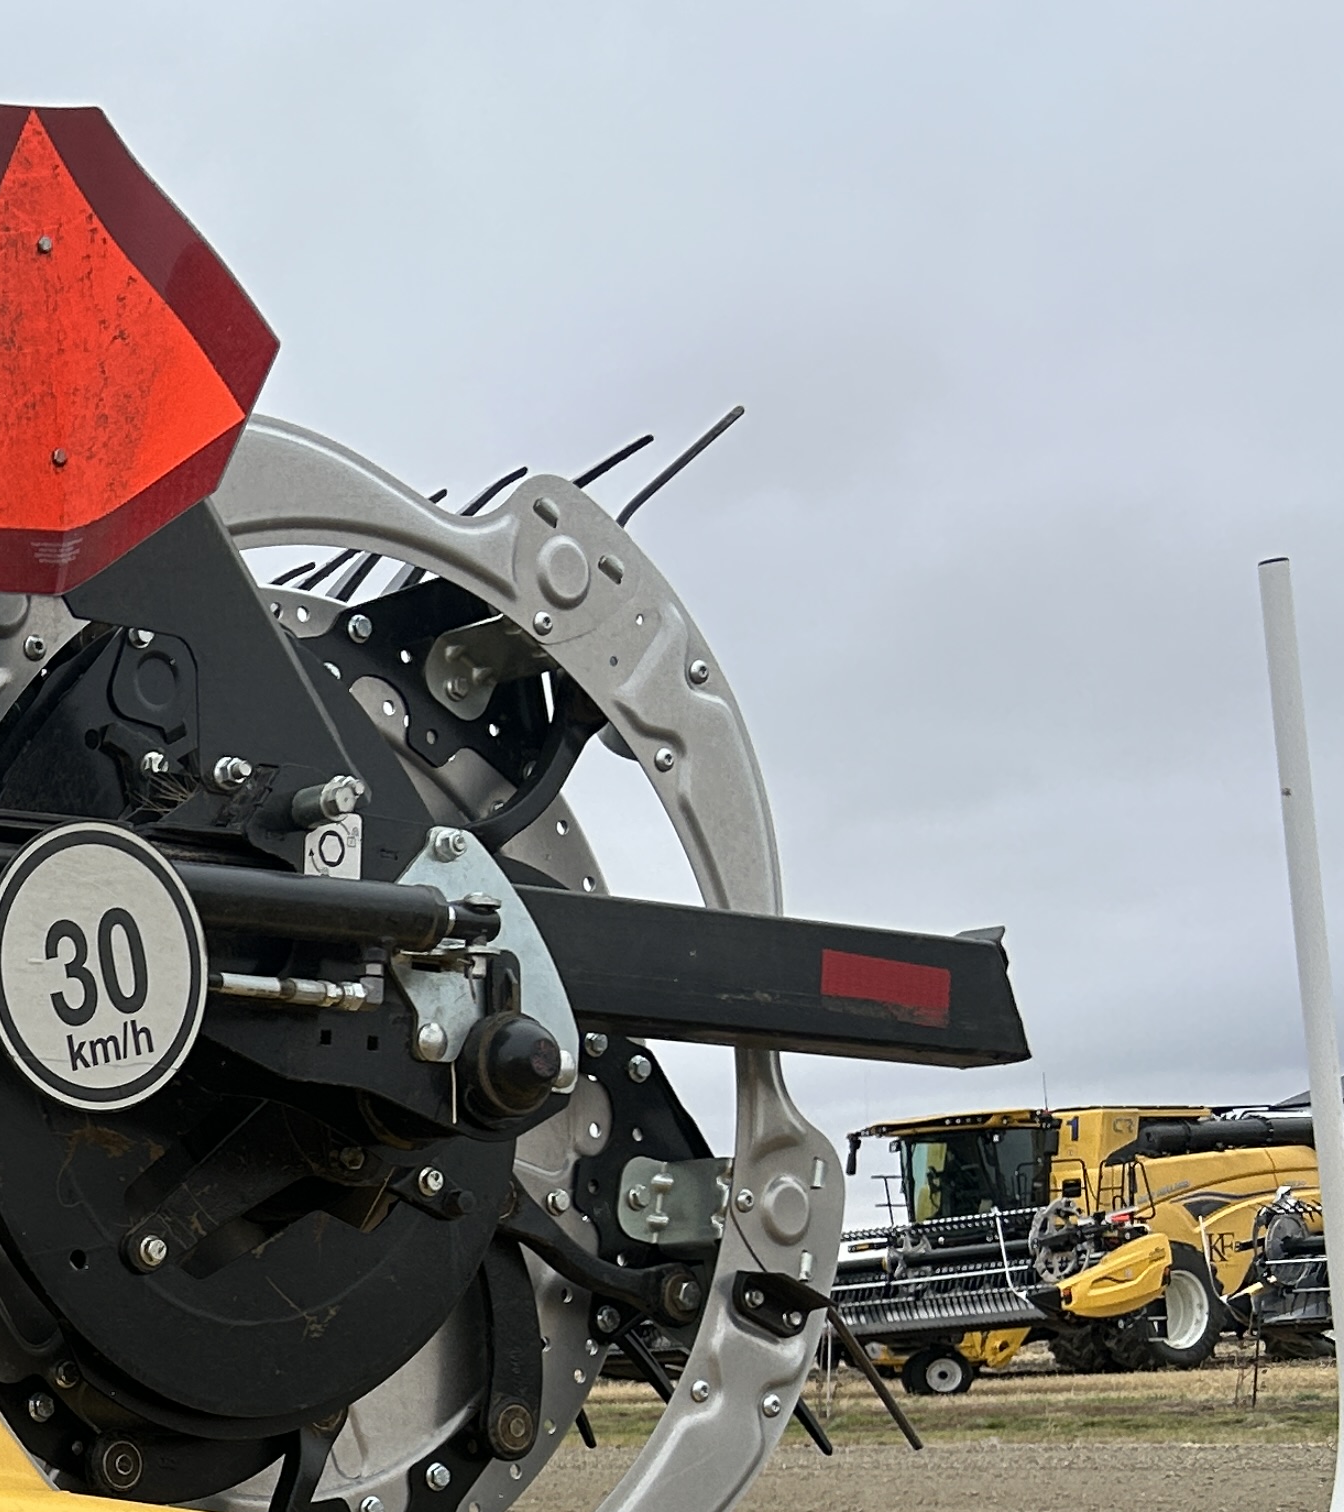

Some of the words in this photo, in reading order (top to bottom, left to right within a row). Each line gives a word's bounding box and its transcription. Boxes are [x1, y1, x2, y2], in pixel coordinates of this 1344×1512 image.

[45, 907, 148, 1027] 30
[66, 1020, 154, 1071] km/h
[1066, 1116, 1079, 1141] 1
